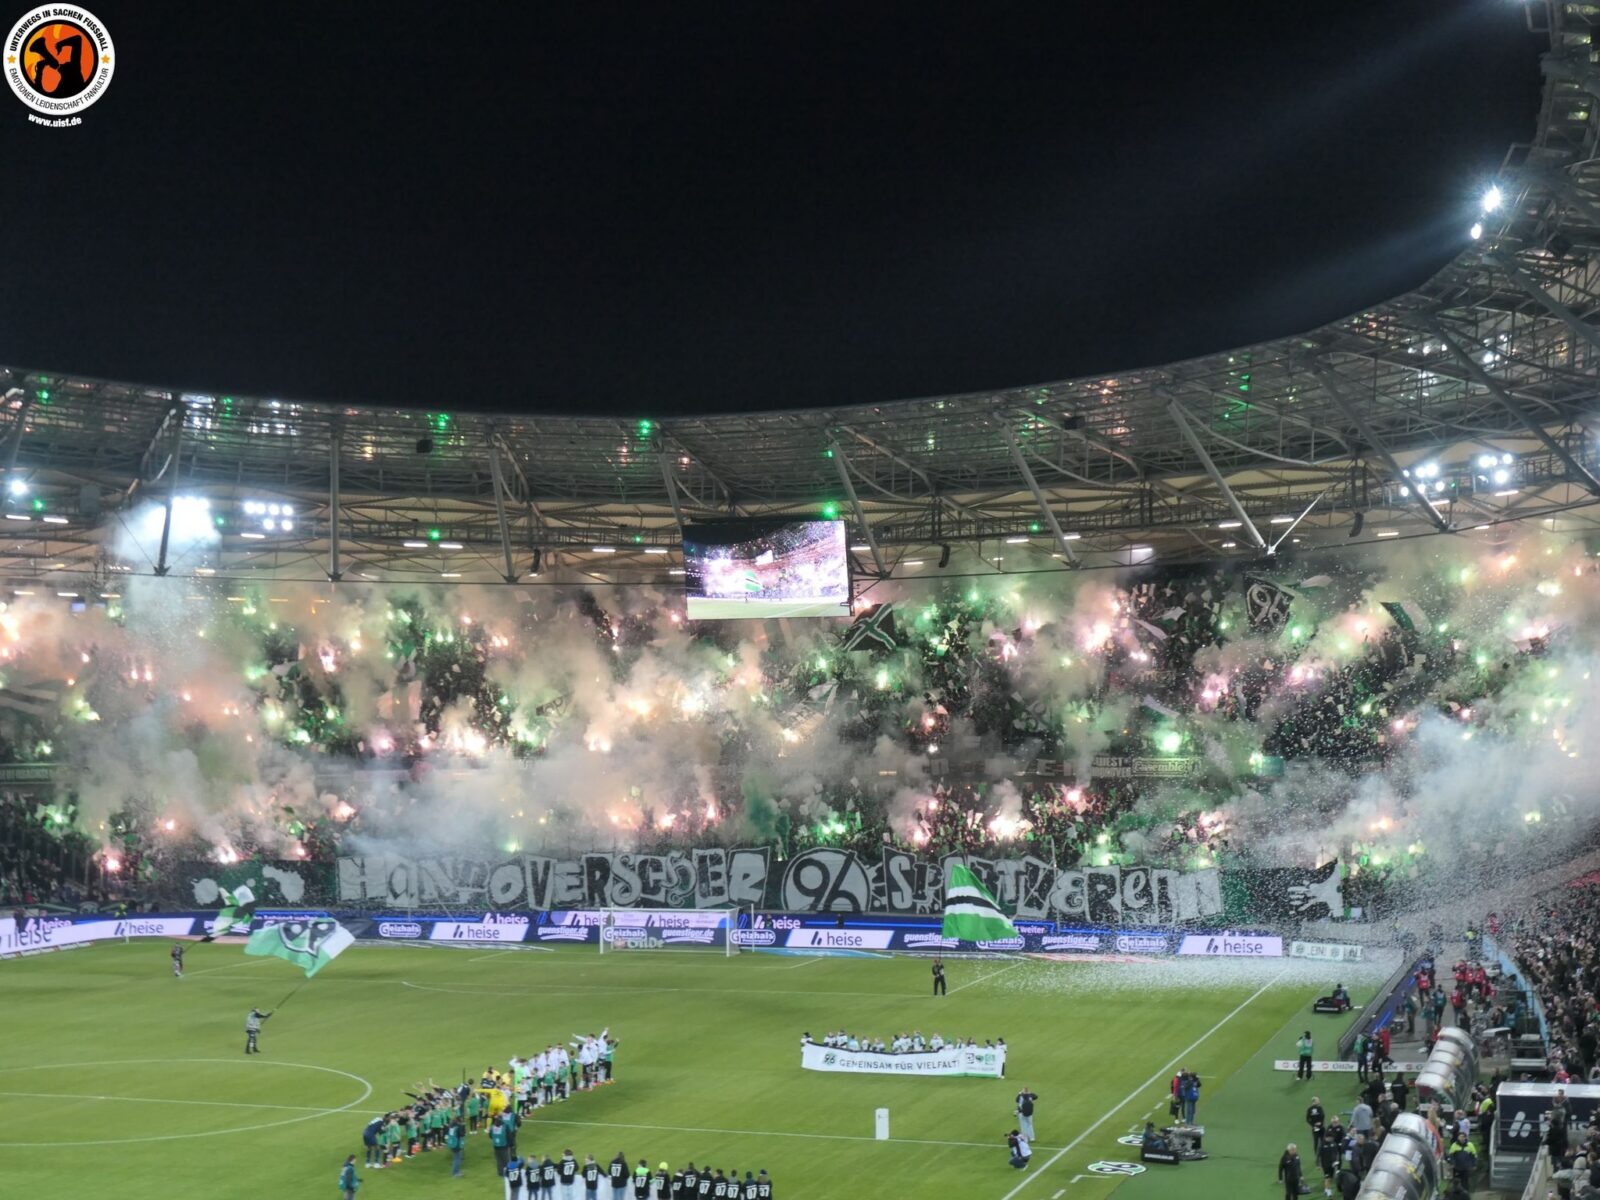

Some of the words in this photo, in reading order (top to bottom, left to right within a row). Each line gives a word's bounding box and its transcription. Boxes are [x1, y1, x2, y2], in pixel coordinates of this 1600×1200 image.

[497, 914, 529, 925] heise
[659, 914, 690, 928] heise
[129, 922, 164, 935] heise
[468, 926, 500, 939] heise
[827, 932, 862, 946] heise
[1224, 938, 1262, 954] heise
[840, 1060, 892, 1070] GEMEINSAM
[895, 1060, 913, 1070] FÜR
[564, 1164, 574, 1176] 07
[587, 1170, 597, 1181] 07
[611, 1166, 621, 1176] 07
[686, 1177, 696, 1188] 07
[700, 1182, 710, 1194] 07
[728, 1186, 739, 1198] 07
[746, 1188, 757, 1200] 07
